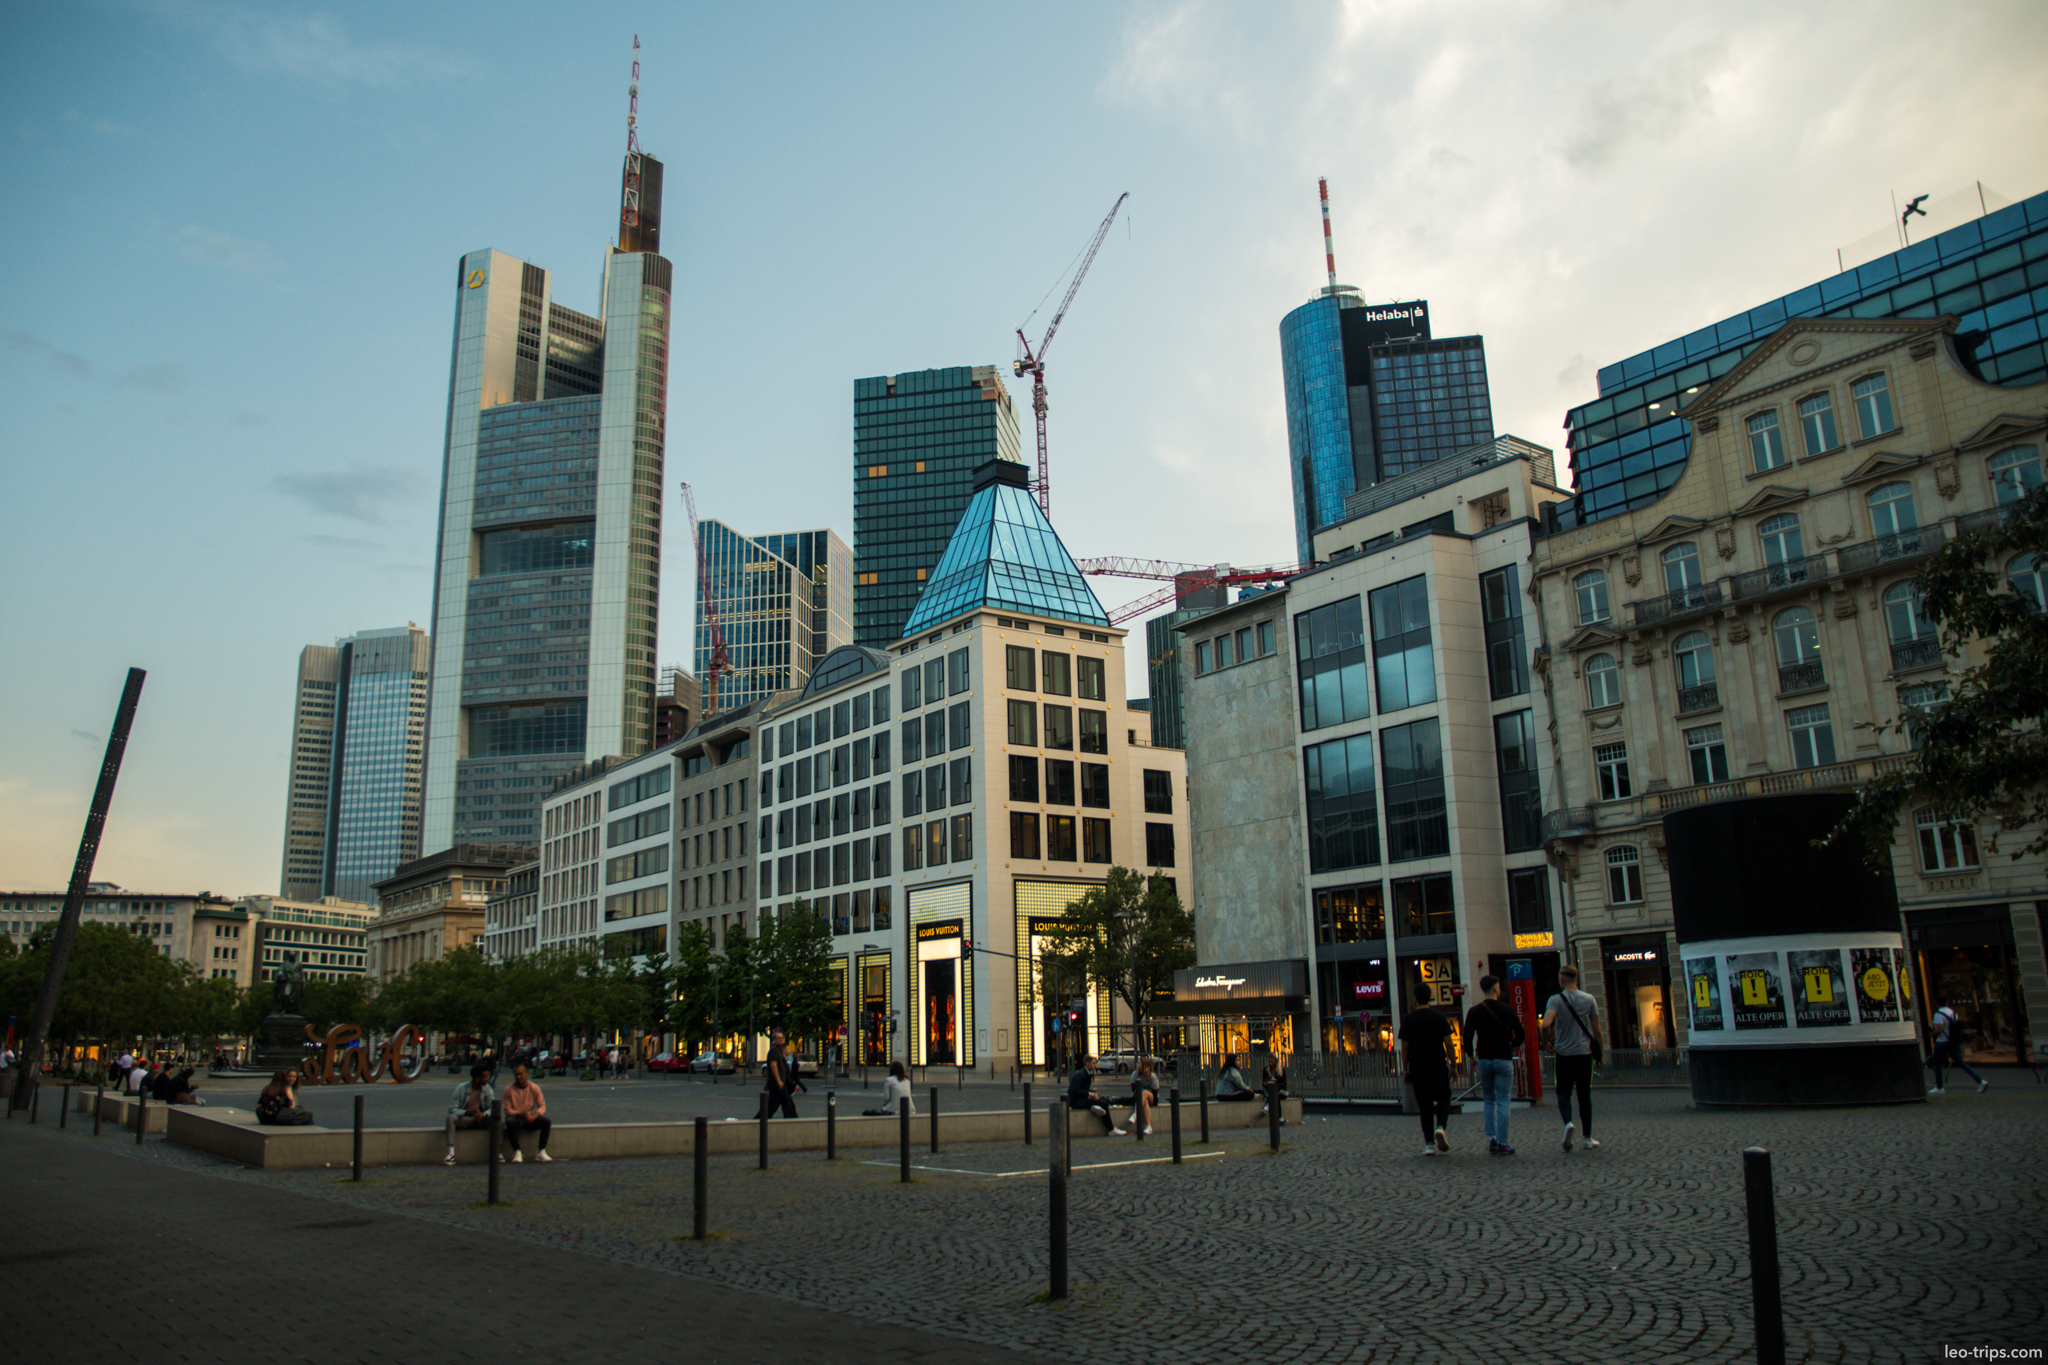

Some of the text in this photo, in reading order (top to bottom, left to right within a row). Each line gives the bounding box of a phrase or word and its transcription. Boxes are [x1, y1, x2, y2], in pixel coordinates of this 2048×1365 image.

[1365, 308, 1410, 322] Helaba
[918, 924, 960, 938] LOUIS VUITTON
[1614, 952, 1643, 962] LACOSTE
[1734, 969, 1773, 980] EROICA
[1796, 966, 1836, 976] EROICA
[1866, 973, 1882, 981] ABO
[1867, 980, 1887, 988] JETZT
[1705, 1014, 1722, 1023] OPER
[1736, 1011, 1786, 1022] ALTE OPER
[1797, 1009, 1850, 1020] ALTE OPER
[1637, 1035, 1657, 1046] SALE
